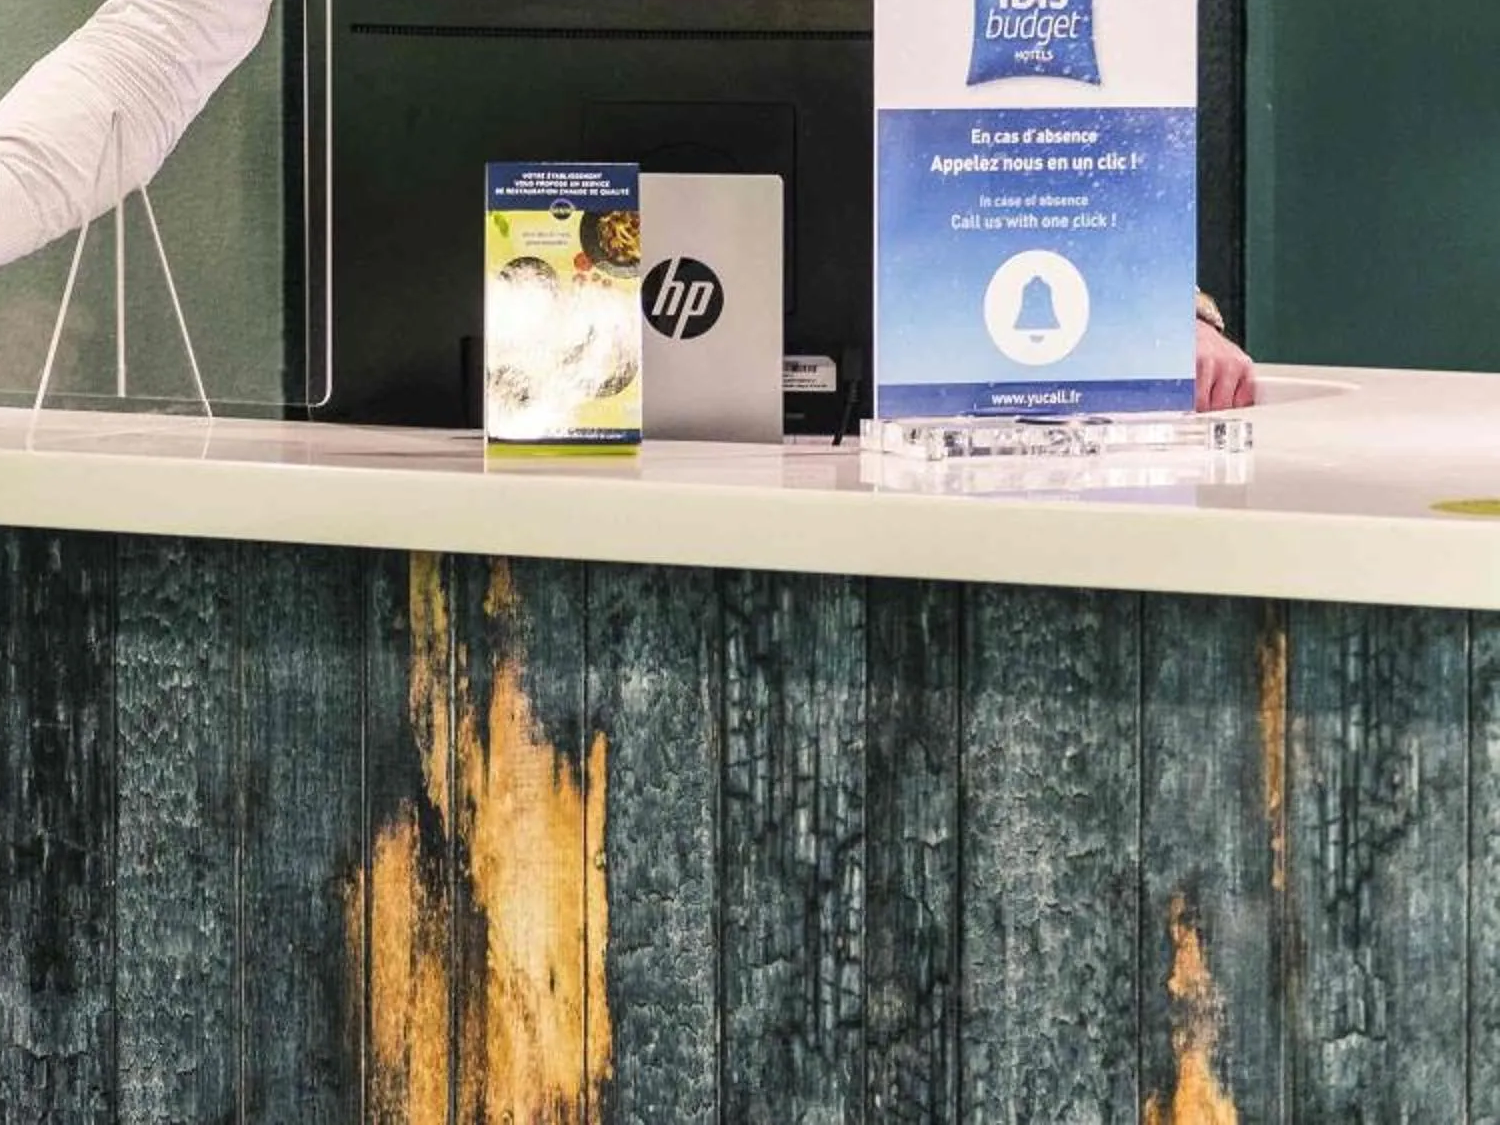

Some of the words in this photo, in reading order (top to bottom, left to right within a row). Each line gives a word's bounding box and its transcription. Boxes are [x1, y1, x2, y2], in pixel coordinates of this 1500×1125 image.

[985, 8, 1081, 46] budget
[1015, 50, 1054, 61] HOTELS
[971, 129, 990, 144] En
[994, 131, 1018, 144] cas
[1023, 128, 1098, 144] d'absence
[931, 154, 999, 174] Appelez
[1003, 156, 1043, 171] nous
[1047, 157, 1069, 171] en
[1072, 156, 1093, 170] un
[1097, 152, 1126, 170] clic
[1131, 152, 1137, 170] !
[979, 195, 992, 207] In
[994, 197, 1021, 207] case
[1024, 195, 1037, 206] of
[1039, 195, 1089, 207] absence
[951, 214, 980, 229] Call
[984, 217, 1000, 229] us
[1002, 213, 1033, 228] with
[1041, 216, 1069, 228] one
[1073, 212, 1107, 227] click
[650, 257, 715, 340] hp
